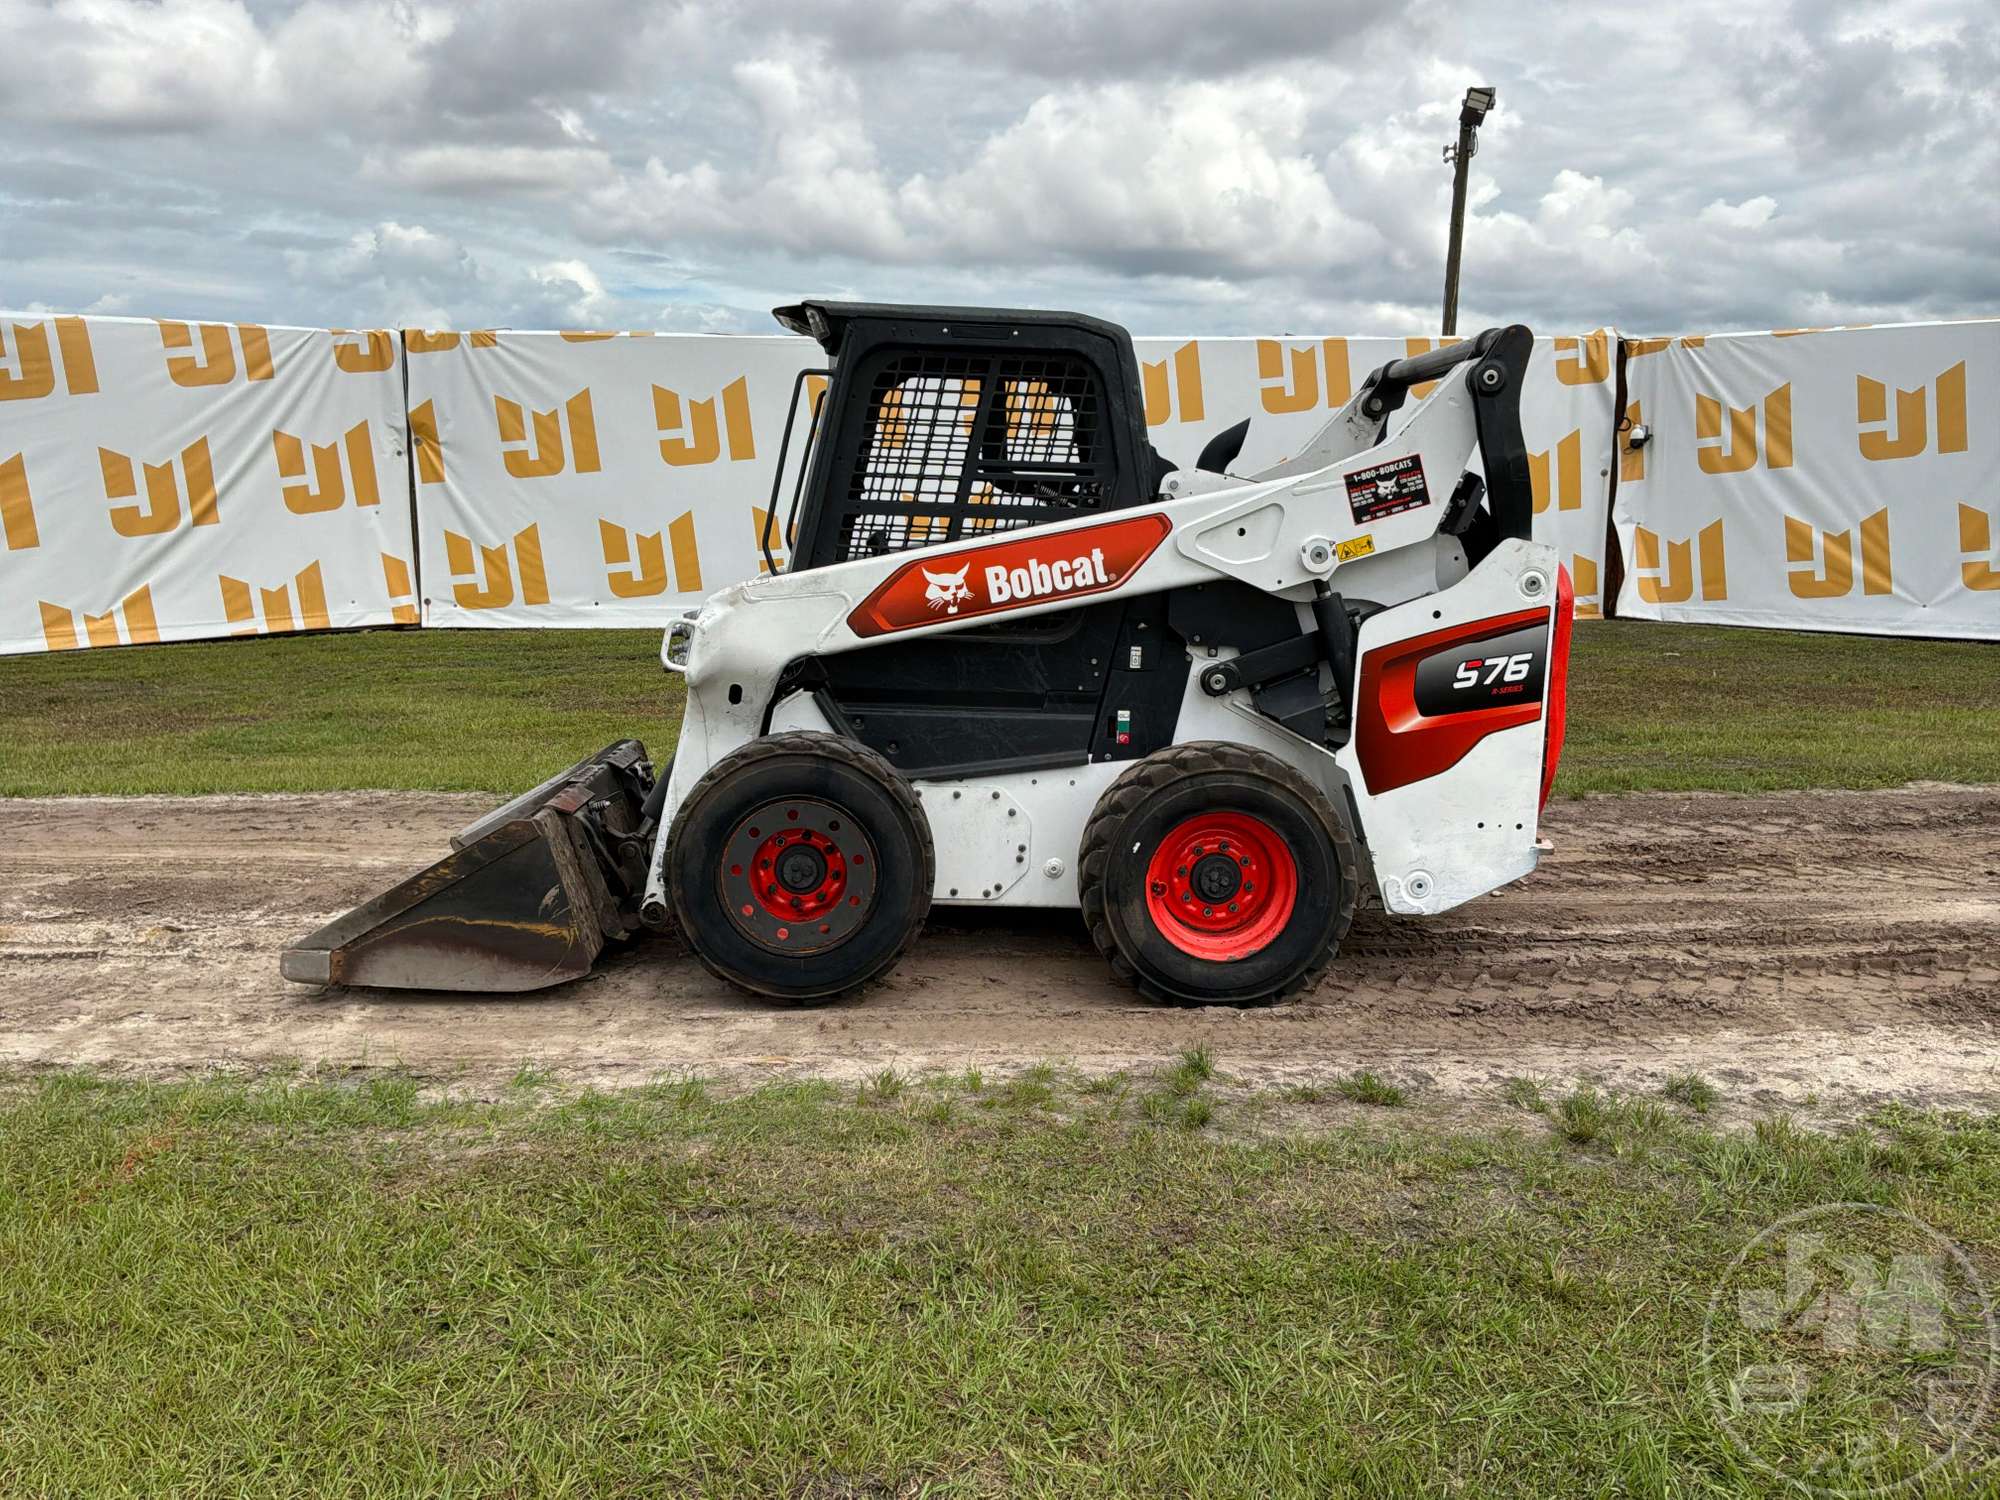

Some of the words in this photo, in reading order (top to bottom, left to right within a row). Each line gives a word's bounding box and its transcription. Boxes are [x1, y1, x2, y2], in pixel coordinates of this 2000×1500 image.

[1353, 459, 1412, 482] 1-800-BOBCATS
[985, 548, 1107, 604] Bobcat
[1453, 652, 1533, 689] S76
